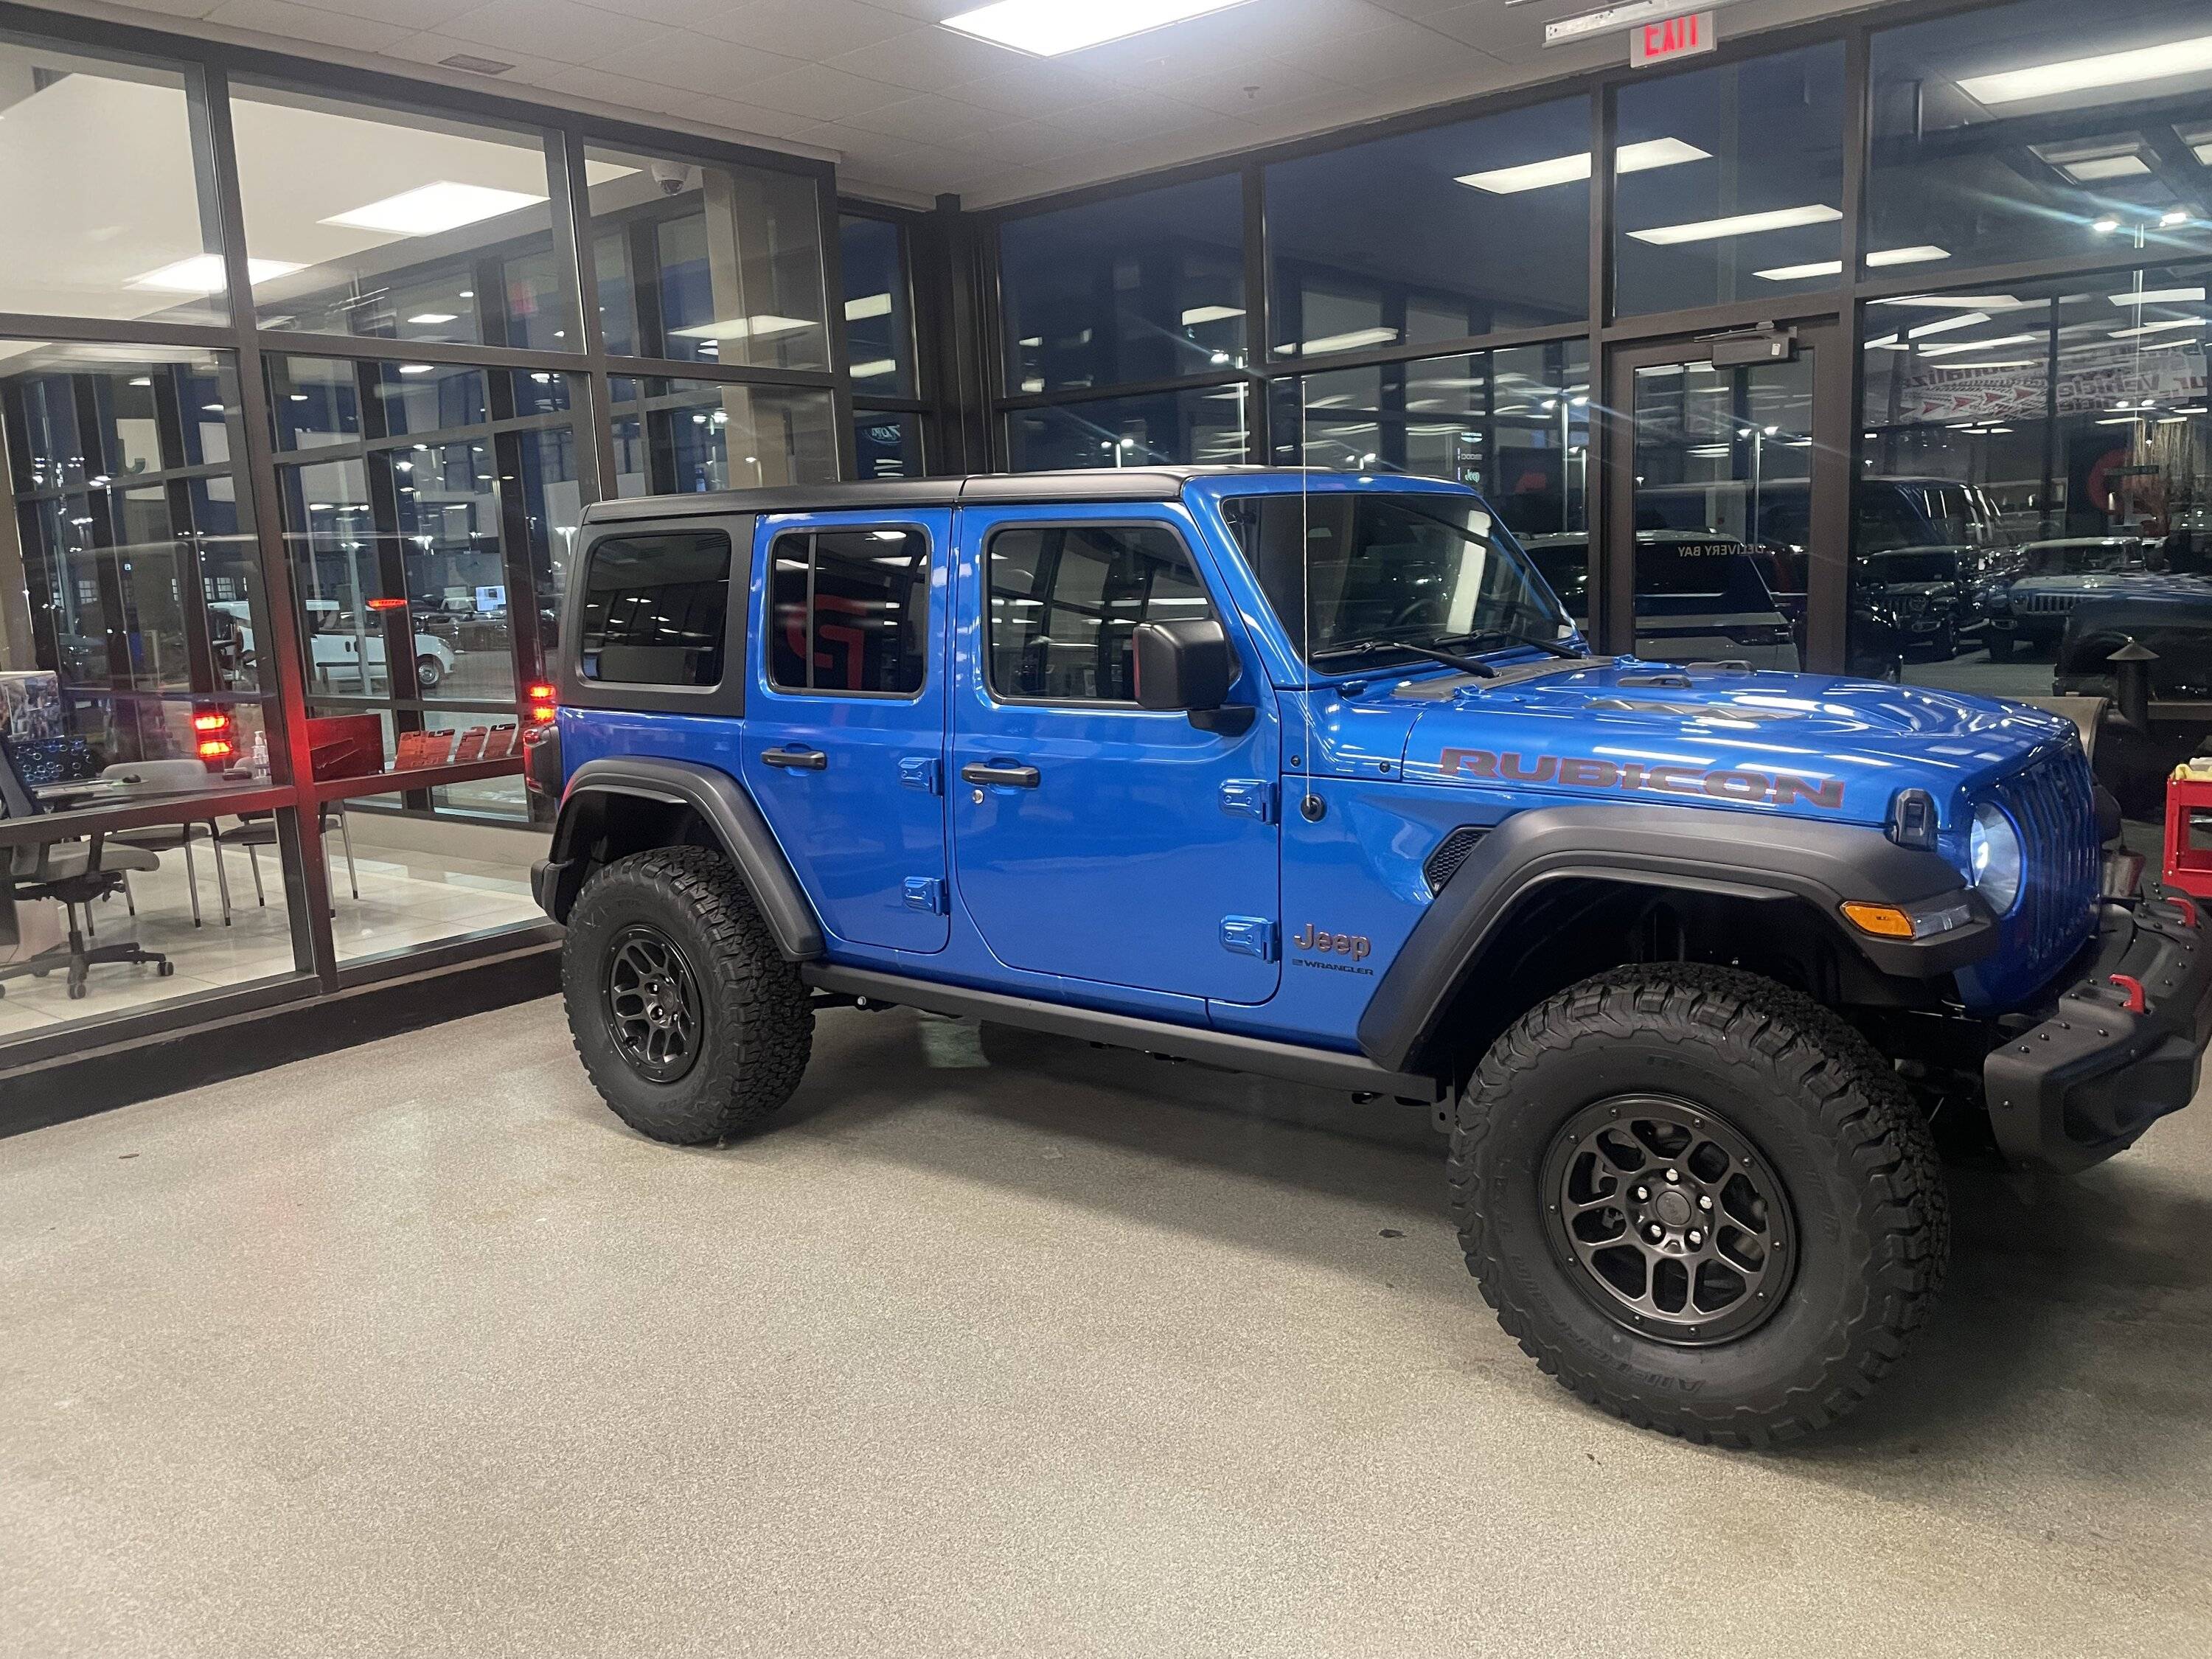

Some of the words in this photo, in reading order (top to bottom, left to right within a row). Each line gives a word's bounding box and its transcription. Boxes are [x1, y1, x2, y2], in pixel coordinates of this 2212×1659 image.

[1439, 747, 1845, 809] RUBICON
[1293, 923, 1371, 961] Jeep
[1304, 959, 1374, 975] WRANGLER
